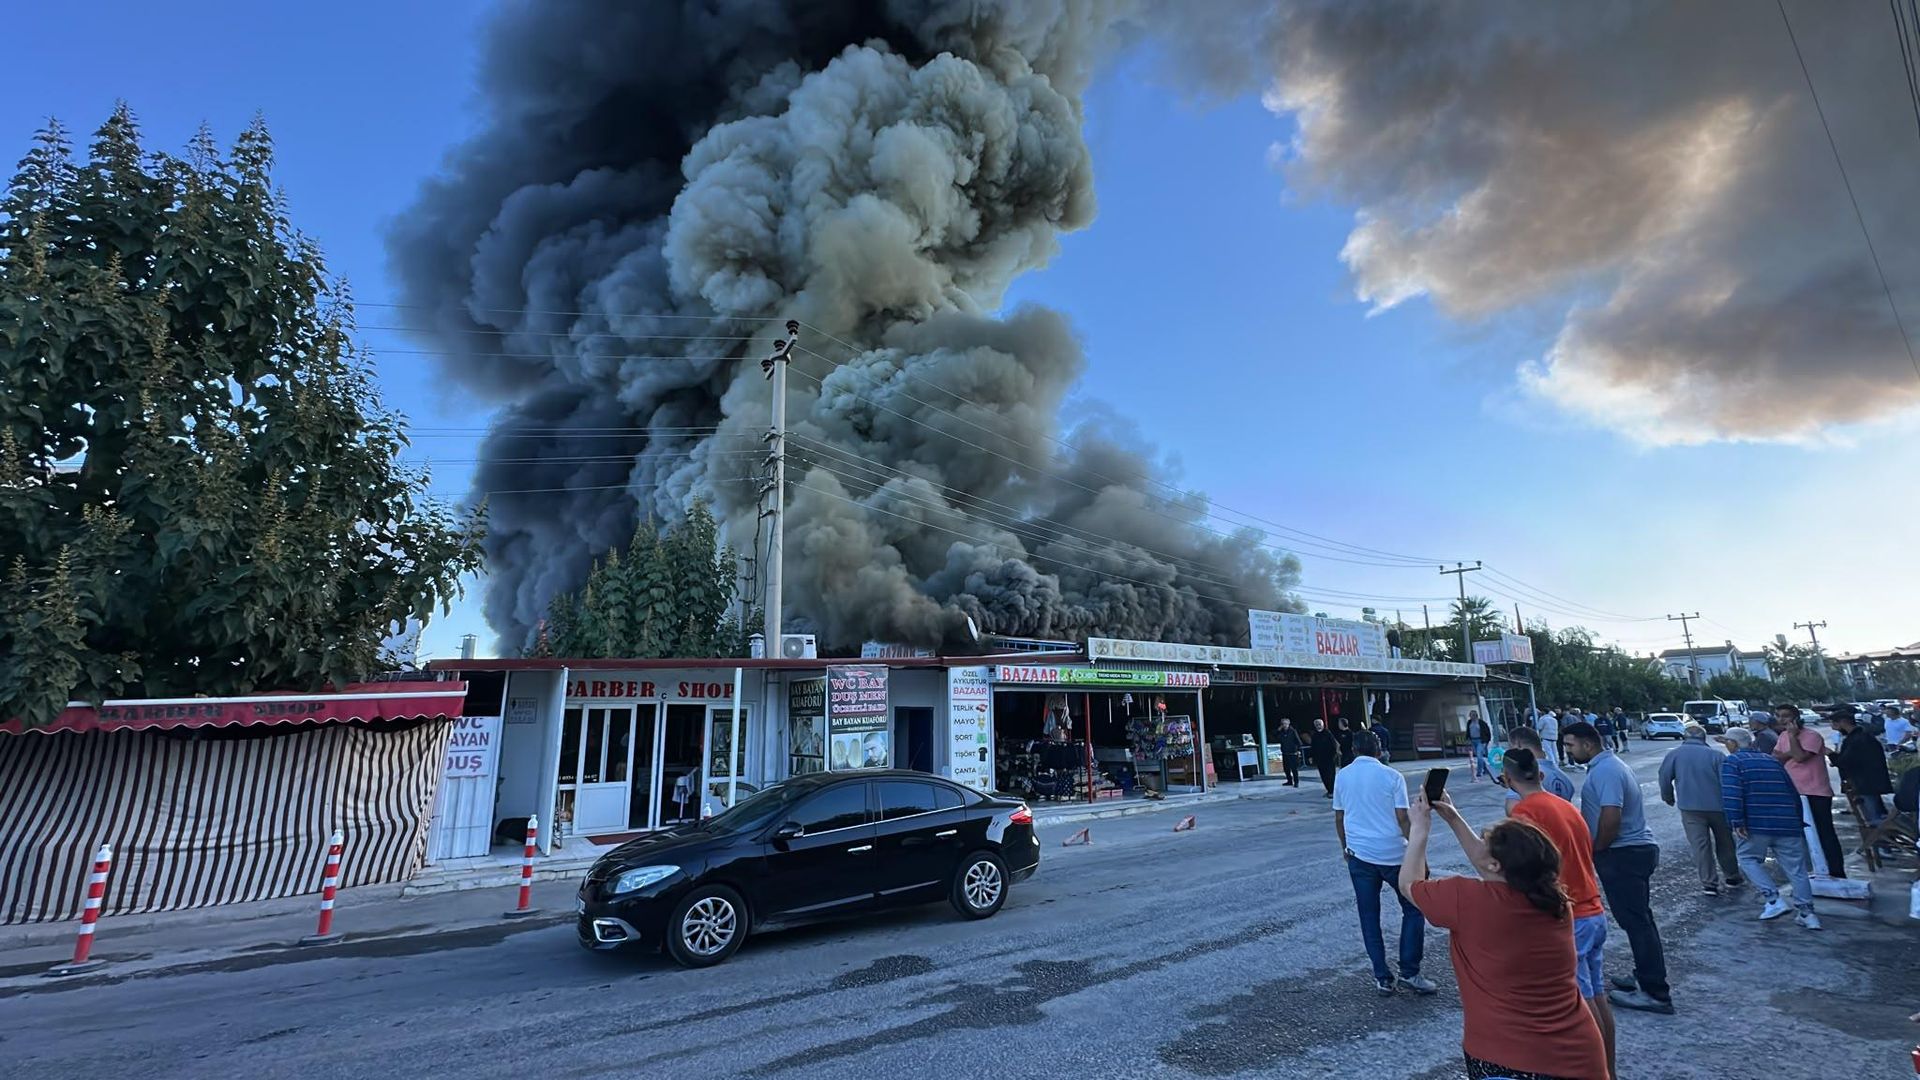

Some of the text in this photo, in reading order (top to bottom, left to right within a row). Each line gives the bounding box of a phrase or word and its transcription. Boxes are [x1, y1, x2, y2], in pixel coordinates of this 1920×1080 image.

[1316, 632, 1360, 656] BAZAAR
[1002, 667, 1057, 682] BAZAAR
[1167, 673, 1208, 687] BAZAAR
[678, 681, 735, 699] SHOP
[831, 678, 885, 690] WC BAY
[831, 691, 858, 704] DUŞ
[953, 687, 987, 695] BAZAAR
[453, 717, 484, 730] WC
[832, 718, 843, 726] BAY
[844, 717, 861, 725] BAYAN
[450, 732, 489, 746] AYAN
[955, 734, 973, 742] ŞORT
